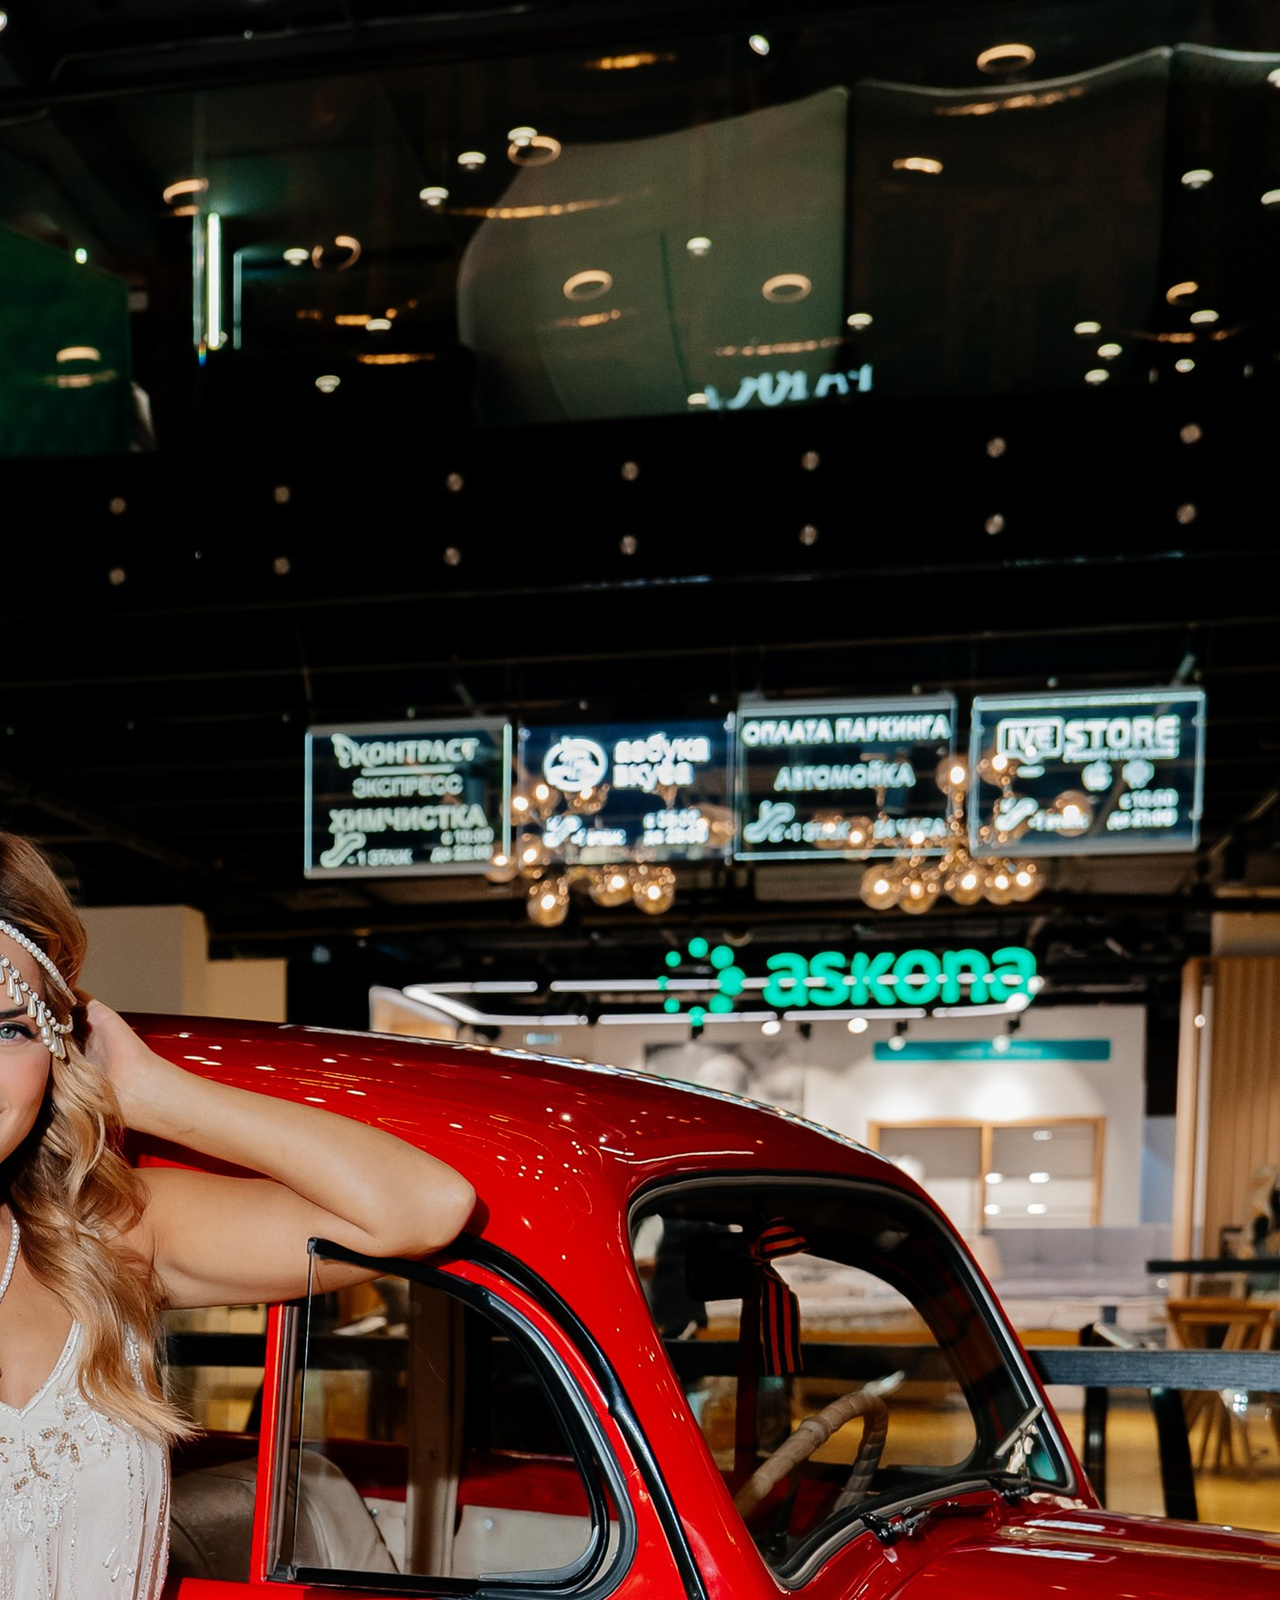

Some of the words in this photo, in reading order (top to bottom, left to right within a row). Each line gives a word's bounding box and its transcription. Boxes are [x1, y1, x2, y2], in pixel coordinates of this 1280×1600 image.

[742, 718, 834, 747] ОПЛАТА
[835, 714, 952, 743] ПАРКИНГА
[1064, 715, 1180, 754] STORE
[352, 774, 464, 798] ЭКСПРЕСС
[773, 760, 917, 791] АВТОМОЙКА
[328, 803, 488, 834] ХИМЧИСТКА
[762, 947, 1036, 1008] askona
